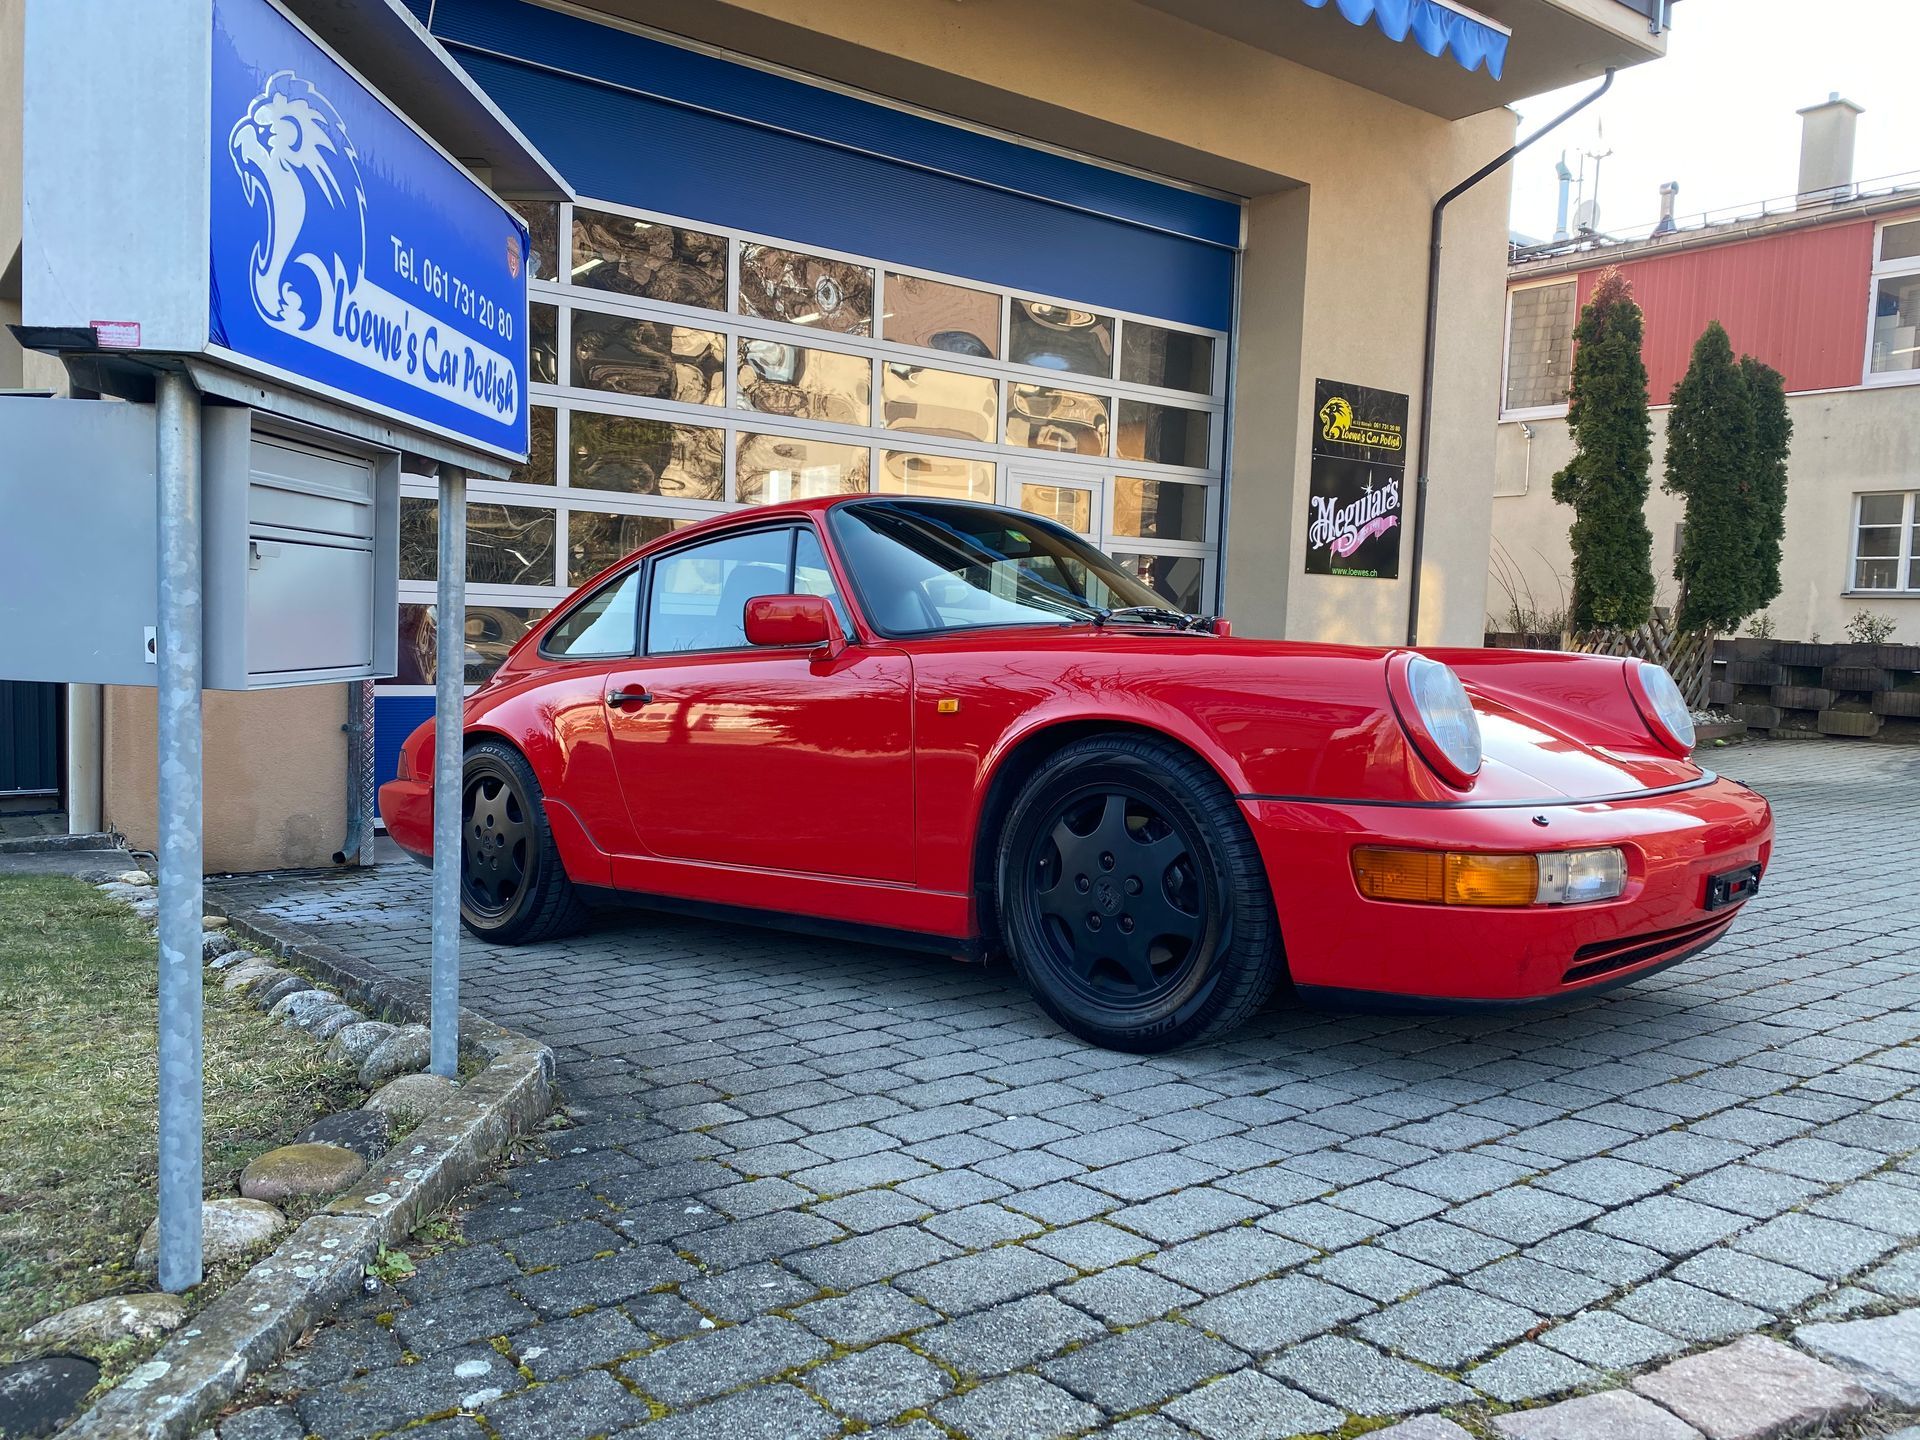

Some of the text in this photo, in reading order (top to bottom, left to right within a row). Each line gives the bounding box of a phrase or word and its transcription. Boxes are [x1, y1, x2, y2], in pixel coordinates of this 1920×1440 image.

[390, 234, 513, 342] Tel. 061 731 20 80
[333, 278, 514, 414] Loewe's Car Polish
[1341, 427, 1400, 447] Loewe's Car Polish
[1309, 477, 1399, 553] Meguiar's
[1331, 567, 1378, 577] www.loewes.ch
